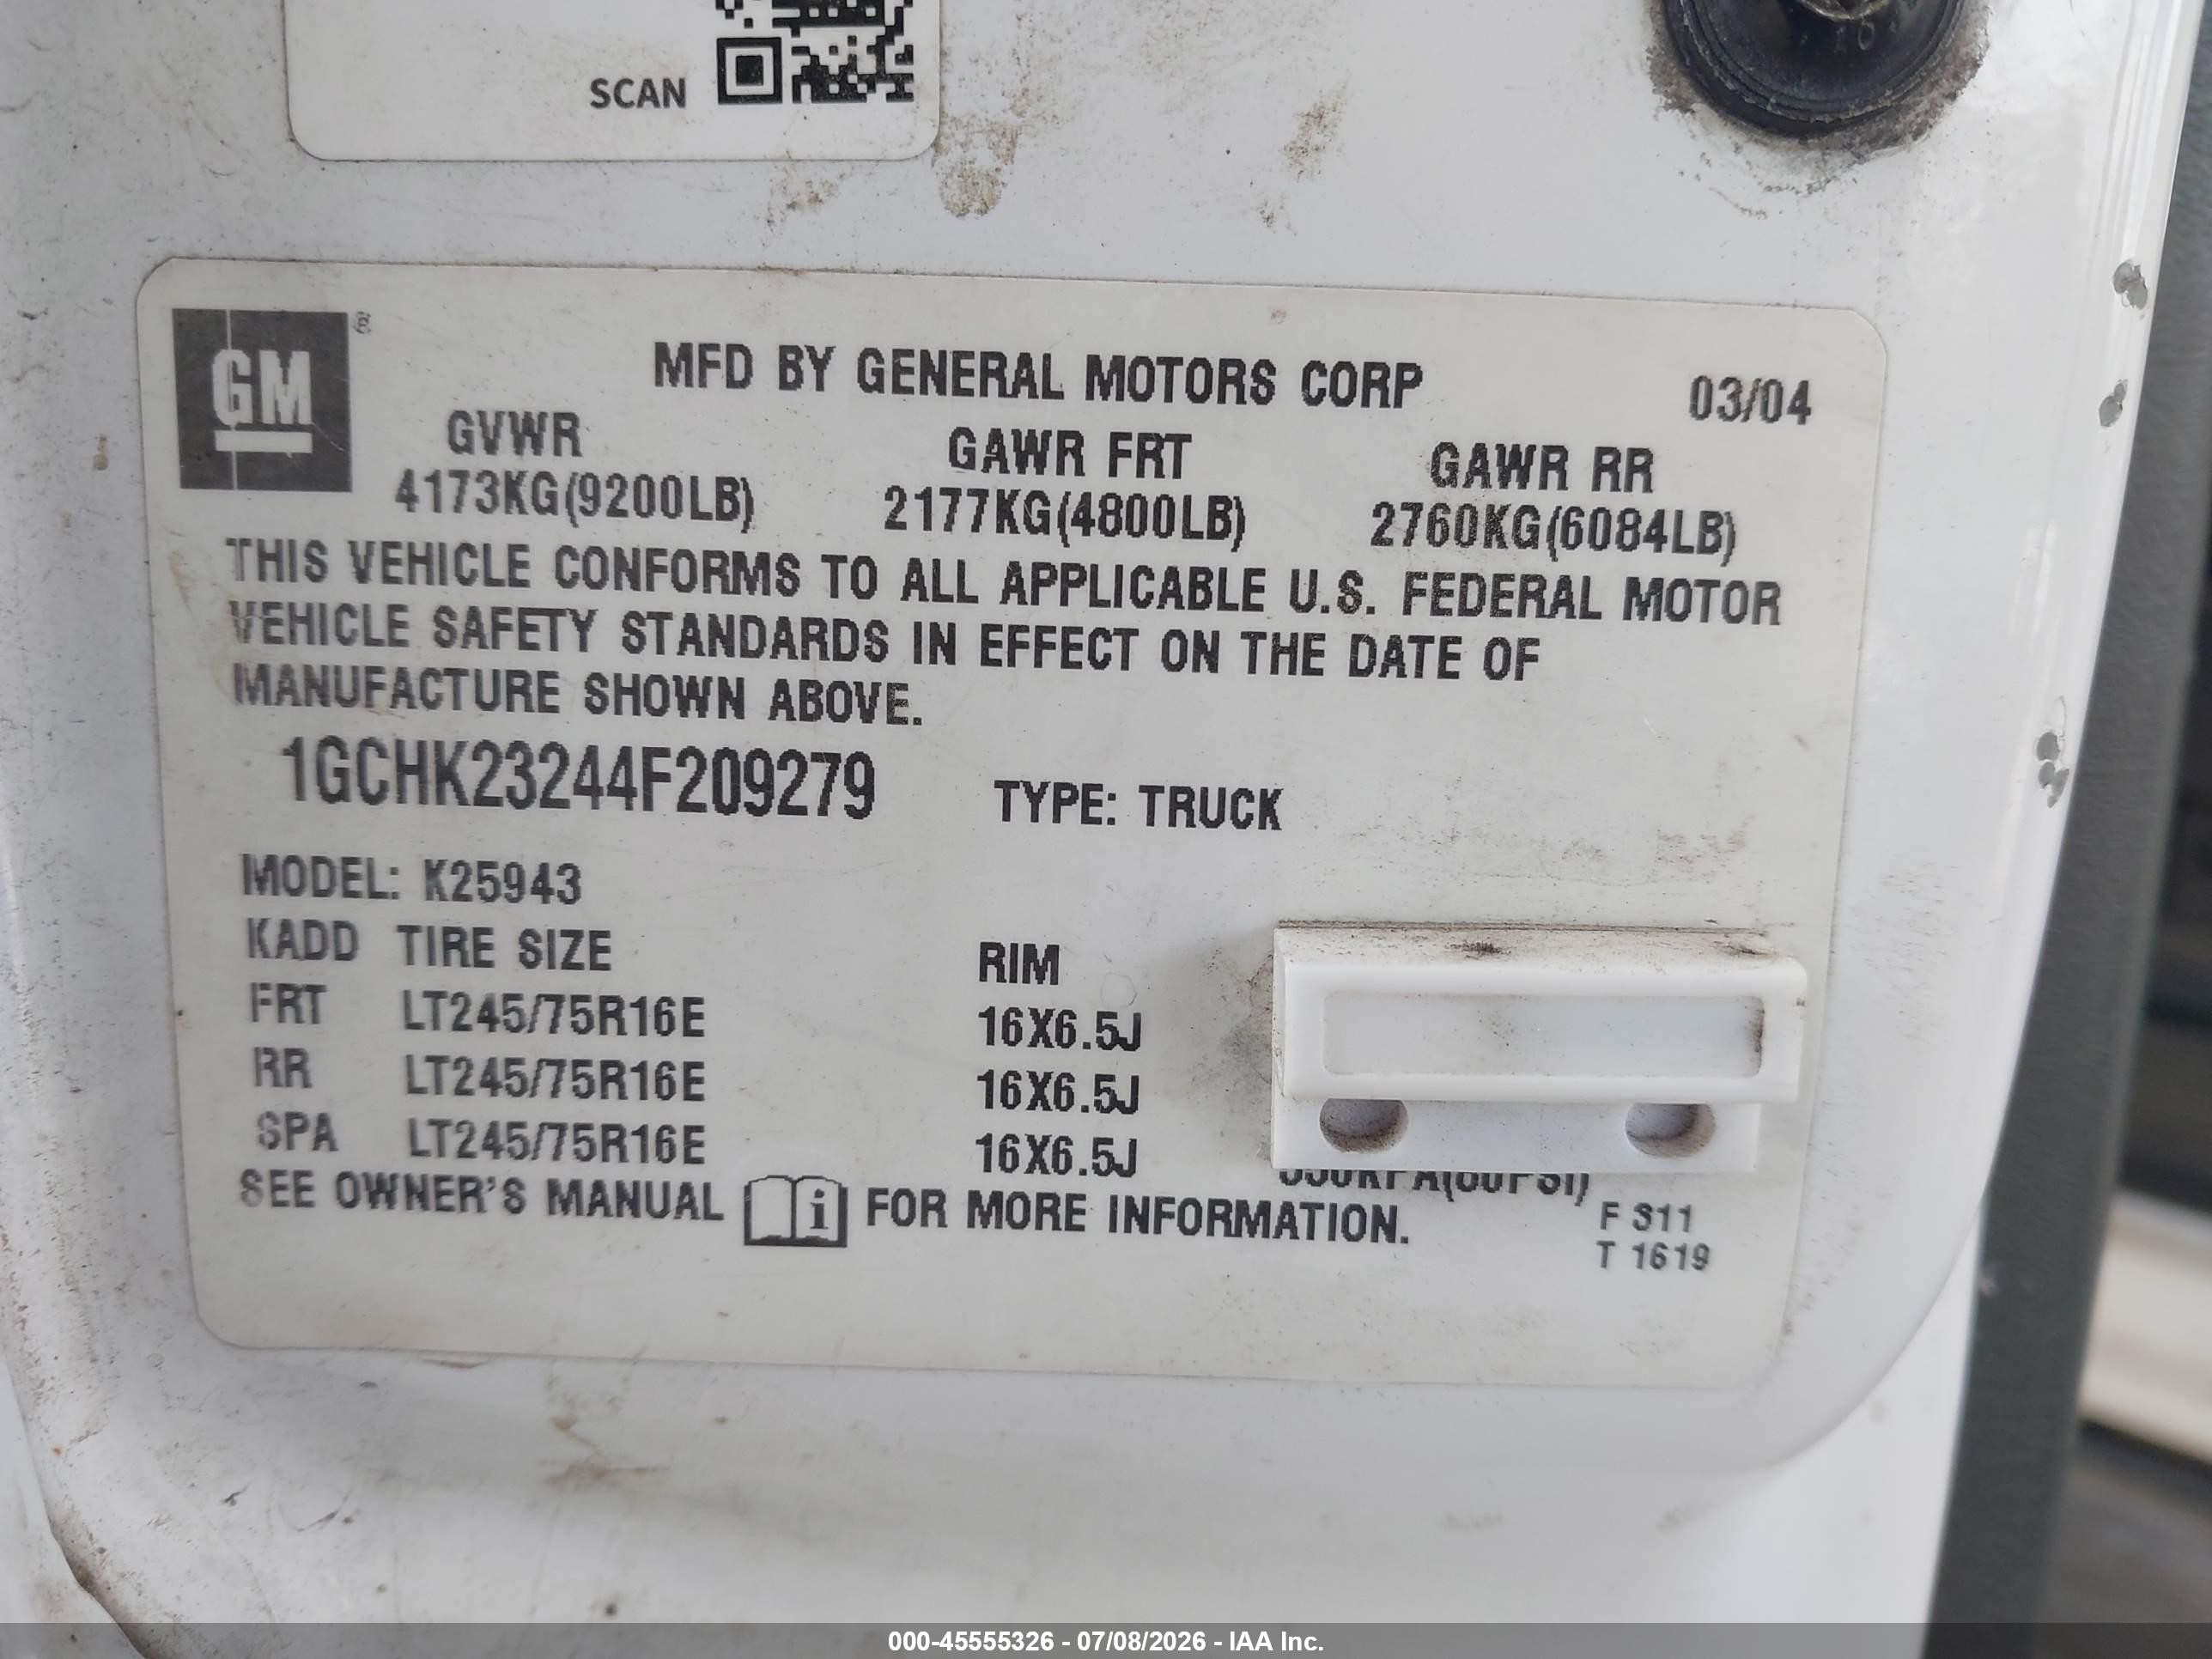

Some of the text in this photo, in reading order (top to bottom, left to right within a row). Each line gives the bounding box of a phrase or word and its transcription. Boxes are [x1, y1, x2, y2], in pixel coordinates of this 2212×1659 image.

[590, 77, 686, 109] SCAN
[212, 349, 313, 426] GM
[655, 342, 1423, 409] MFD BY GENERAL MOTORS CORP
[1689, 375, 1812, 425] 03/04
[447, 410, 582, 457] GVWR
[949, 427, 1192, 479] GAWR FRT
[1427, 442, 1653, 493] GAWR RR
[396, 469, 754, 533] 4173KG(9200LB)
[884, 485, 1245, 552] 2177KG(4800LB)
[1370, 501, 1736, 567] 2760KG(6084LB)
[227, 538, 1781, 625] THIS VEHICLE CONFORMS TO ALL APPLICABLE U.S. FEDERAL MOTOR
[229, 601, 1540, 681] VEHICLE SAFETY STANDARDS IN EFFECT ON THE DATE OF
[234, 663, 921, 726] MANUFACTURE SHOWN ABOVE.
[283, 735, 875, 819] 1GCHK23244F209279
[994, 780, 1284, 830] TYPE: TRUCK
[242, 854, 581, 904] MODEL: K25943
[248, 918, 611, 971] KADD TIRE SIZE
[979, 942, 1060, 985] RIM
[251, 982, 704, 1037] FRT LT245/75R16E
[978, 1006, 1141, 1051] 16X6.5J
[254, 1048, 704, 1102] RR LT245/75R16E
[977, 1069, 1139, 1115] 16X6.5J
[258, 1112, 704, 1164] SPA LT245/75R16E
[975, 1133, 1137, 1177] 16X6.5J
[240, 1169, 1408, 1243] SEE OWNER'S MANUAL FOR MORE INFORMATION.
[1601, 1201, 1619, 1230] F
[1597, 1241, 1710, 1271] T 1619
